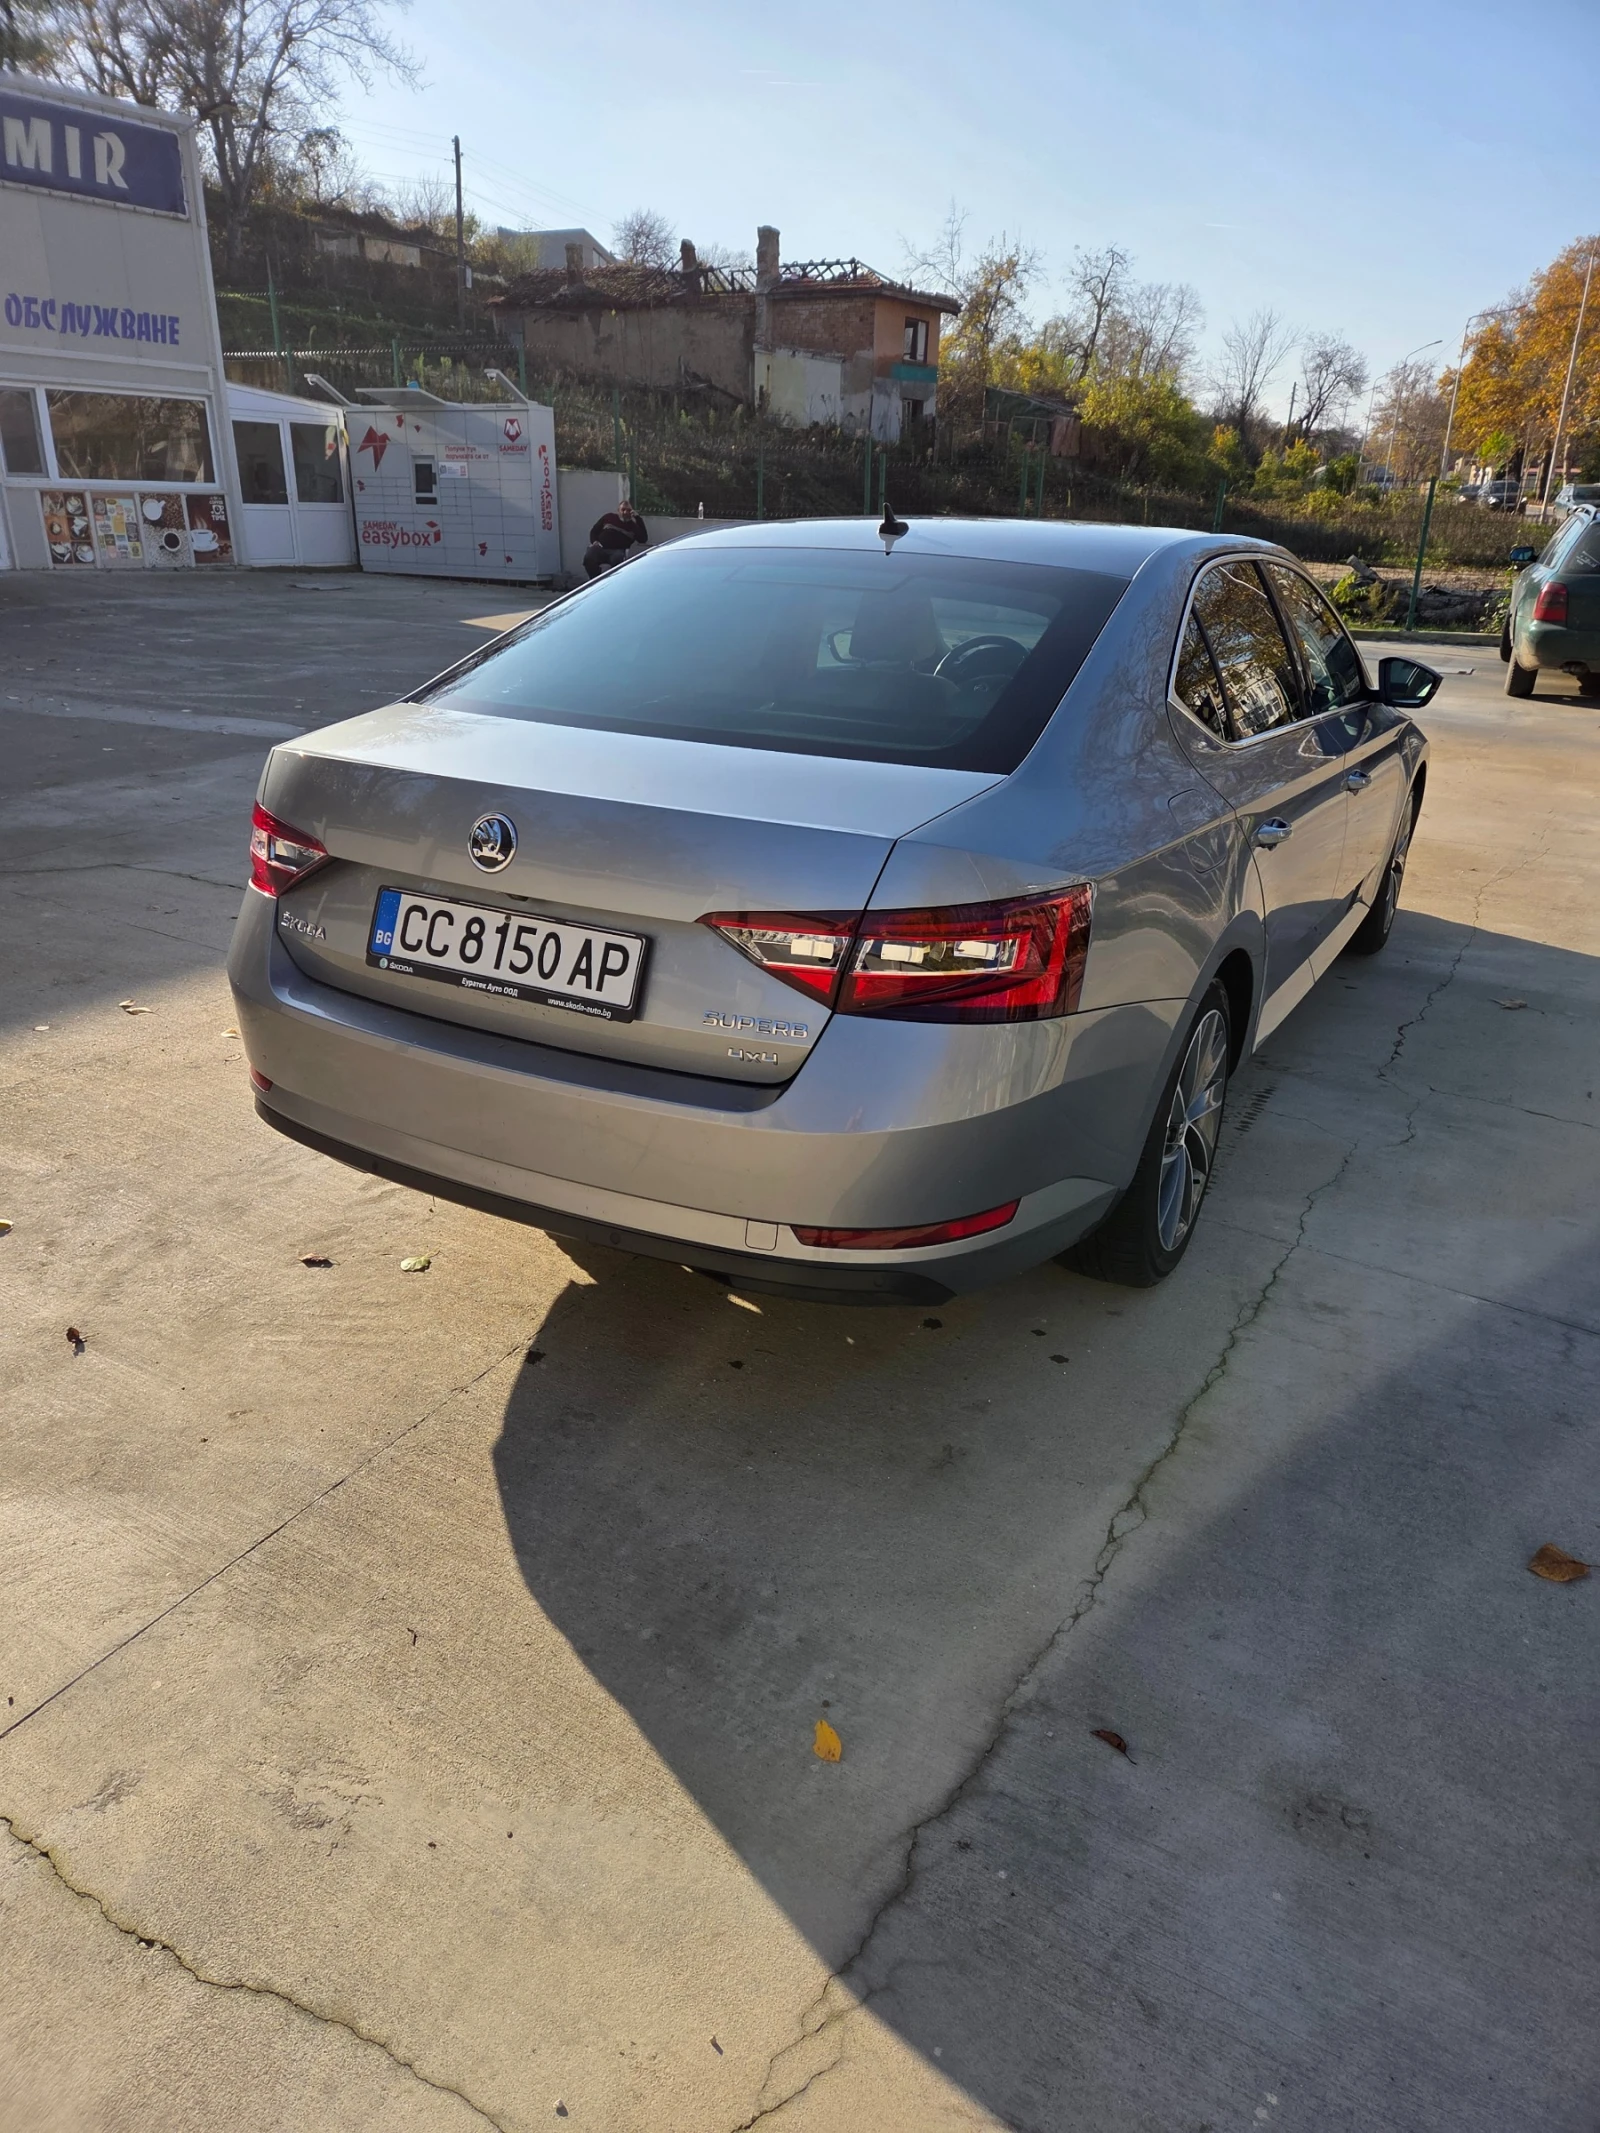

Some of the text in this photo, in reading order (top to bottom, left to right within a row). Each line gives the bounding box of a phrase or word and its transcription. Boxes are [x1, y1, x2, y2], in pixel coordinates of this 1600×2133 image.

[3, 116, 129, 190] MIR
[4, 292, 180, 346] ОБСЛУЖВАНЕ
[543, 456, 552, 531] easybox
[362, 521, 398, 530] SAMEDAY
[362, 526, 431, 549] easybox
[375, 929, 392, 945] BG
[400, 904, 630, 993] CC 8150 AP
[487, 983, 502, 993] Ауто
[503, 987, 518, 997] ООД
[547, 998, 612, 1019] www.skoda-auto.bg
[702, 1009, 809, 1039] SUPERB
